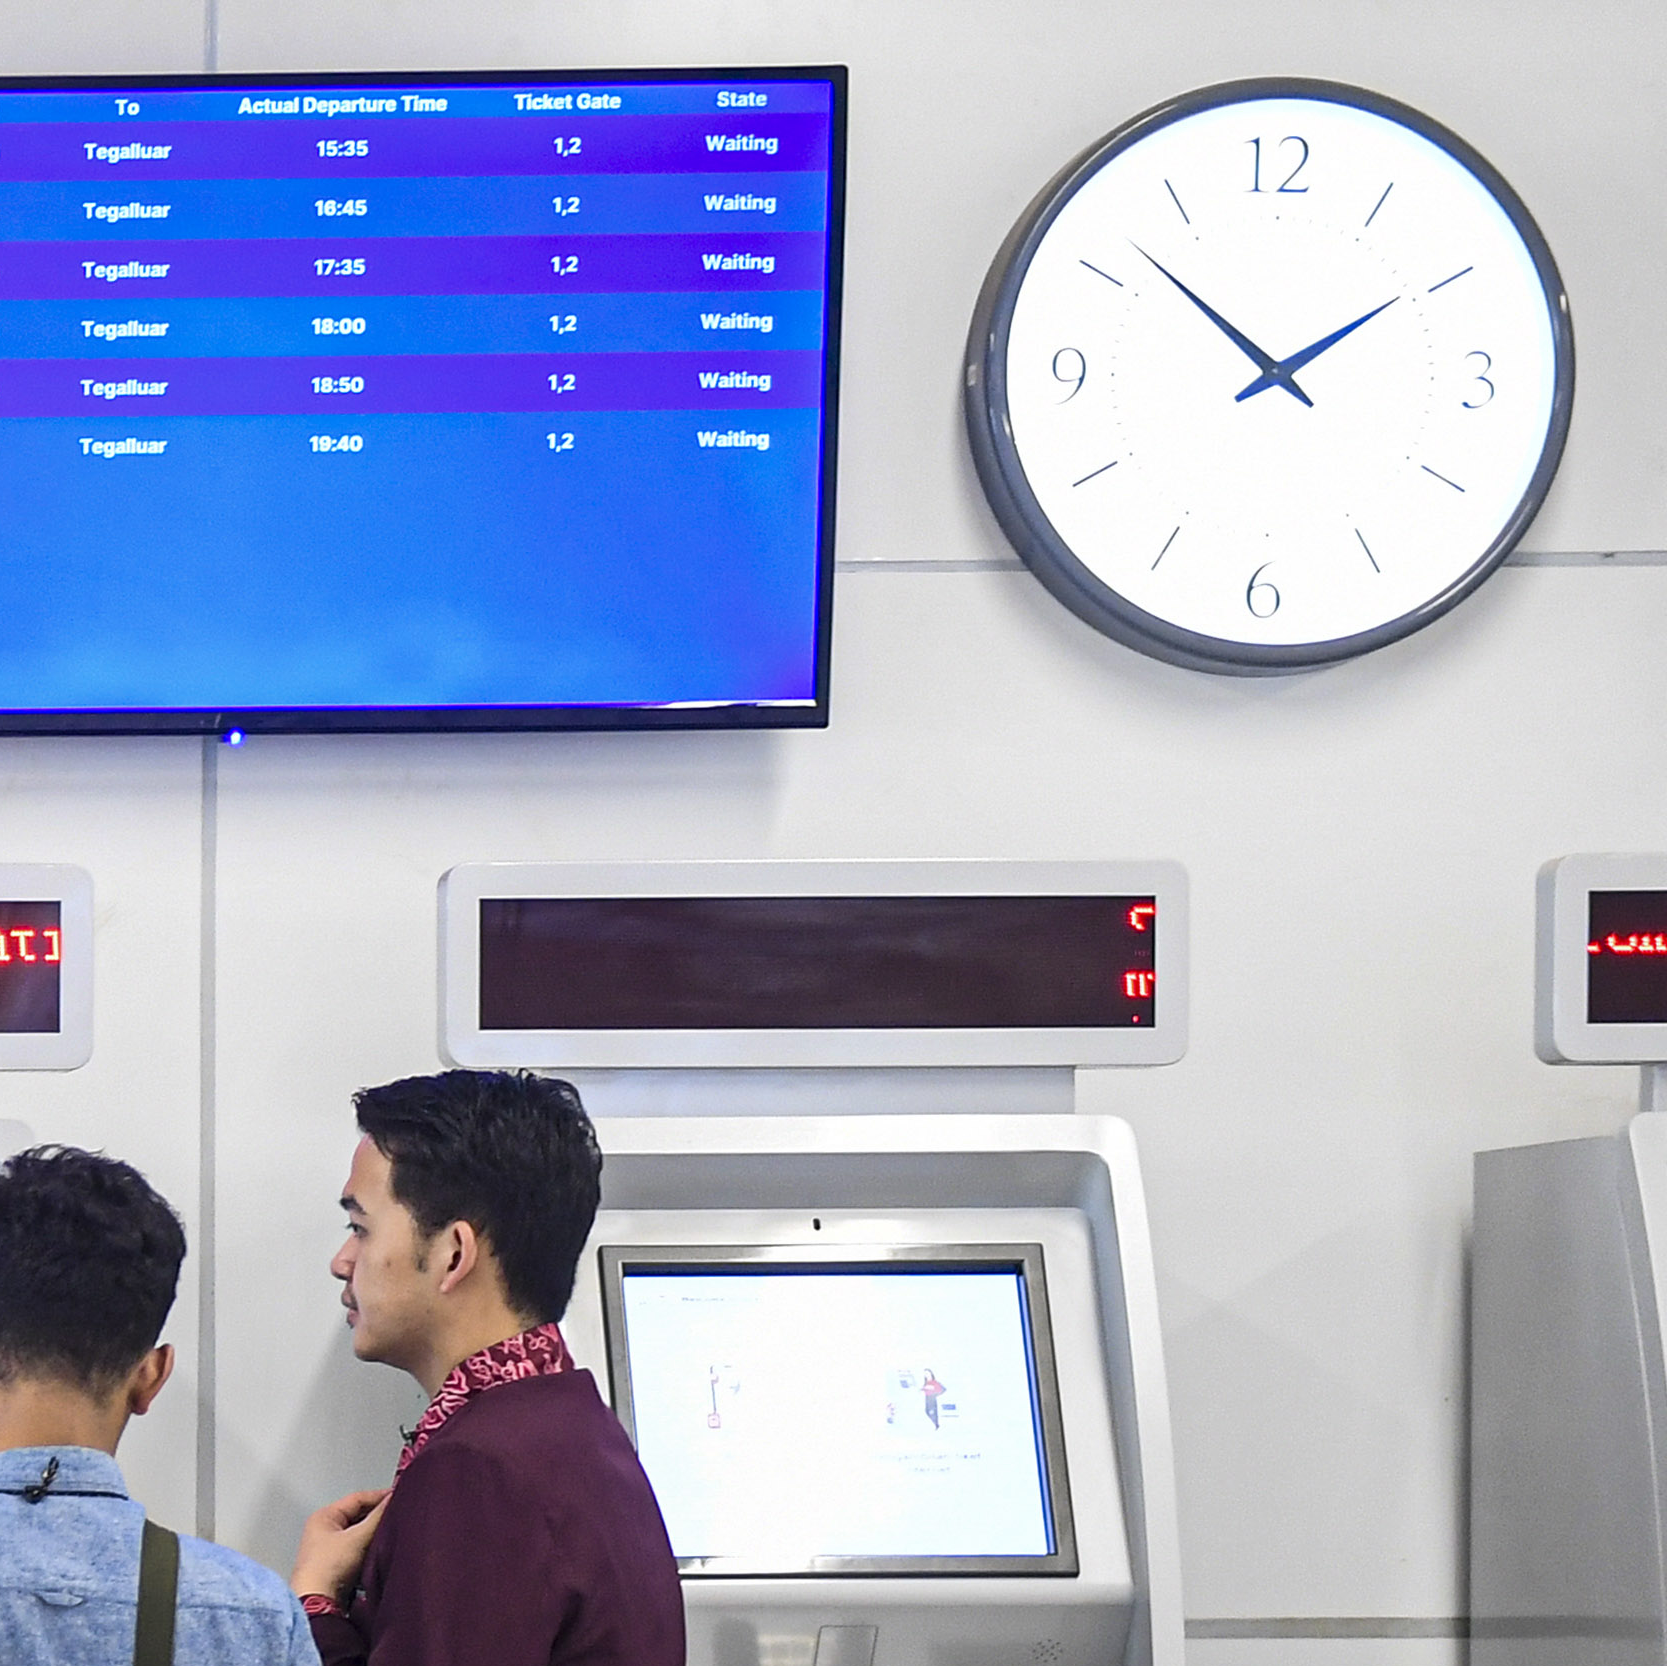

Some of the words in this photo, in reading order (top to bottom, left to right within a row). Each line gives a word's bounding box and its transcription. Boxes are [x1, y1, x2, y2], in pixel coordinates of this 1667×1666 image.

[114, 98, 141, 116] To
[237, 96, 301, 115] Actual
[302, 96, 398, 118] Departure
[399, 94, 449, 113] Time
[513, 92, 574, 111] Ticket
[575, 92, 623, 111] Gate
[716, 90, 768, 108] State
[82, 140, 174, 165] Tegalluar
[314, 138, 370, 159] 15:35
[552, 135, 583, 159] 1,2
[703, 132, 781, 157] Waiting
[1243, 136, 1310, 194] 12
[81, 200, 173, 225] Tegalluar
[313, 197, 369, 218] 16:45
[551, 195, 582, 218] 1,2
[702, 192, 778, 216] Waiting
[80, 259, 172, 283] Tegalluar
[312, 256, 367, 277] 17:35
[549, 254, 580, 278] 1,2
[700, 251, 777, 275] Waiting
[79, 318, 172, 343] Tegalluar
[309, 315, 368, 337] 18:00
[547, 313, 579, 337] 1,2
[698, 310, 775, 335] Waiting
[78, 377, 170, 401] Tegalluar
[310, 375, 366, 395] 18:50
[546, 372, 577, 396] 1,2
[697, 369, 773, 393] Waiting
[1052, 347, 1087, 405] 9
[1461, 351, 1495, 409] 3
[77, 436, 169, 460] Tegalluar
[307, 433, 365, 454] 19:40
[545, 431, 576, 454] 1,2
[695, 428, 772, 453] Waiting
[1246, 560, 1281, 618] 6
